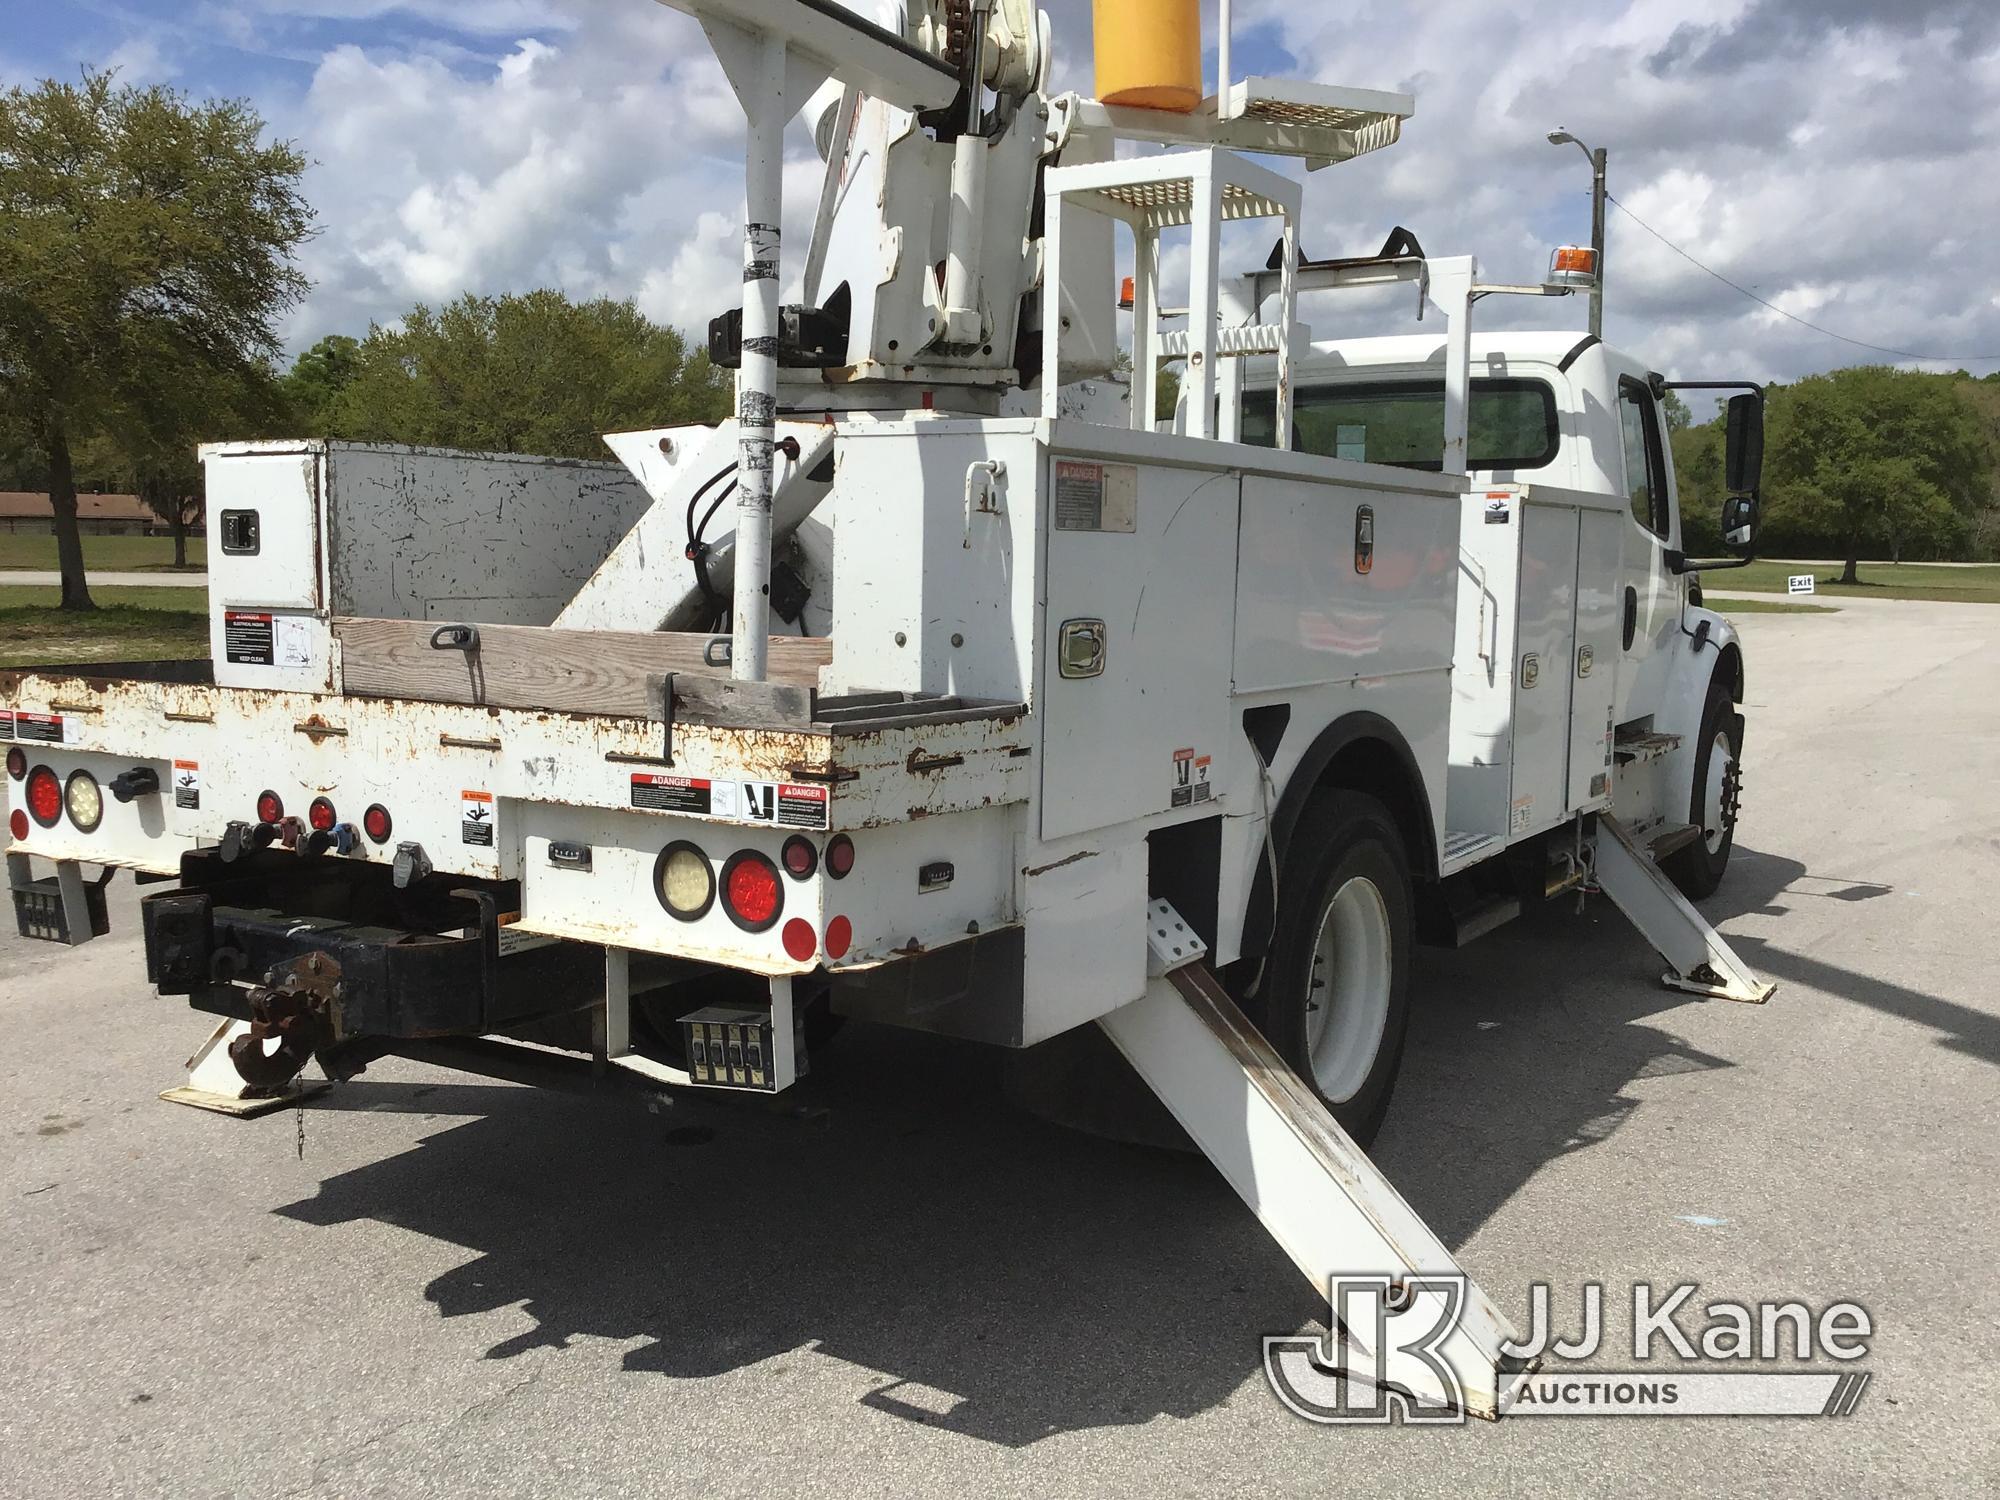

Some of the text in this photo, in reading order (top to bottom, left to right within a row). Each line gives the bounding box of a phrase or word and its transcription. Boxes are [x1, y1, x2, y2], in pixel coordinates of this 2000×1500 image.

[1790, 577, 1811, 587] Exit
[658, 776, 692, 787] DANGER
[792, 787, 821, 798] DANGER
